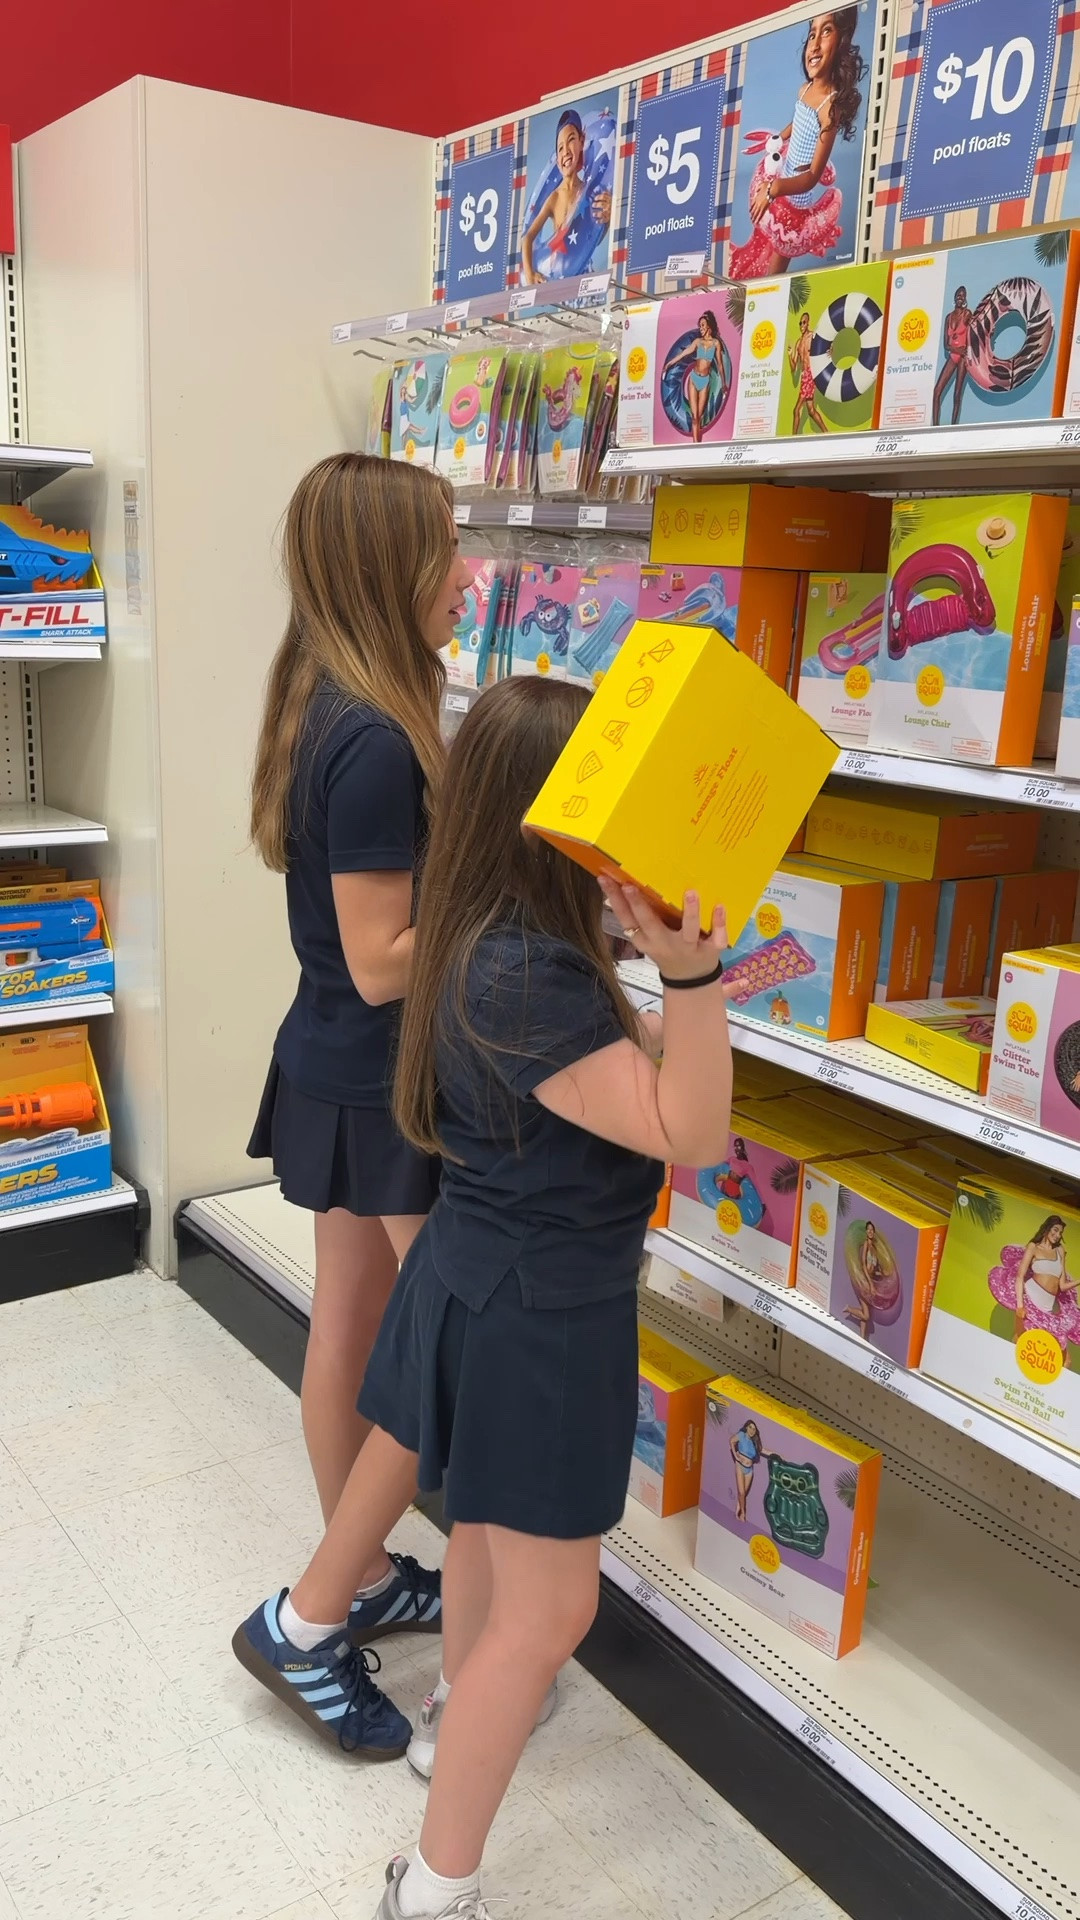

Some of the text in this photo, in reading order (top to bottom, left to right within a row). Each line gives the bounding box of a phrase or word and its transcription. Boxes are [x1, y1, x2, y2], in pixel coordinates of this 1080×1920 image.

[933, 36, 1035, 121] $10
[933, 132, 1011, 165] pool floats
[647, 126, 701, 205] $5
[459, 188, 499, 253] $3
[645, 215, 694, 240] pool floats
[458, 261, 494, 281] pool floats
[904, 317, 924, 331] SUN
[900, 329, 926, 343] SQUAD
[752, 339, 773, 351] SQUAD
[741, 368, 779, 380] Swim Tube
[886, 363, 933, 375] Swim Tube
[750, 379, 767, 388] with
[620, 391, 651, 401] Swim Tube
[744, 389, 772, 399] Handles
[875, 443, 897, 452] 10.00
[724, 452, 742, 461] 10.00
[40, 628, 93, 637] SHARK ATTACK
[1021, 594, 1040, 672] Lounge Chair
[831, 706, 872, 717] Lounge Flo
[904, 715, 951, 728] Lounge Chair
[844, 759, 865, 769] 10.00
[691, 747, 738, 826] Lounge Float
[1023, 787, 1050, 798] 10.00
[773, 888, 797, 901] Pocket
[848, 929, 861, 995] Pocket Lounge
[1, 971, 88, 998] SOAKERS
[1011, 1010, 1033, 1025] SUN
[1008, 1019, 1034, 1034] SQUAD
[1005, 1042, 1030, 1054] INFLATABLE
[1002, 1048, 1031, 1065] Glitter
[817, 1066, 838, 1079] 10.00
[993, 1054, 1040, 1078] Swim Tube
[56, 1134, 102, 1149] GATLING PULSE
[979, 1126, 1004, 1141] 10.00
[33, 1145, 76, 1161] MITRAILLEUSE
[77, 1140, 103, 1151] GATLING
[711, 1235, 726, 1247] Swim
[727, 1243, 740, 1253] Tube
[805, 1238, 828, 1257] Confetti
[800, 1251, 830, 1276] Swim Tube
[806, 1248, 825, 1264] Glitter
[928, 1232, 940, 1287] Swim Tube
[753, 1298, 772, 1313] 10.00
[1026, 1340, 1055, 1361] SUN
[1020, 1349, 1056, 1374] SQUAD
[869, 1364, 891, 1381] 10.00
[994, 1377, 1065, 1418] Swim Tube and
[1004, 1392, 1051, 1422] Beach Ball
[740, 1566, 767, 1588] Gummy
[768, 1584, 785, 1598] Bear
[634, 1585, 651, 1601] 10.00
[284, 1663, 305, 1671] SPEZIAL
[800, 1724, 821, 1743] 10.00
[1022, 1896, 1050, 1920] SUN SQUAD
